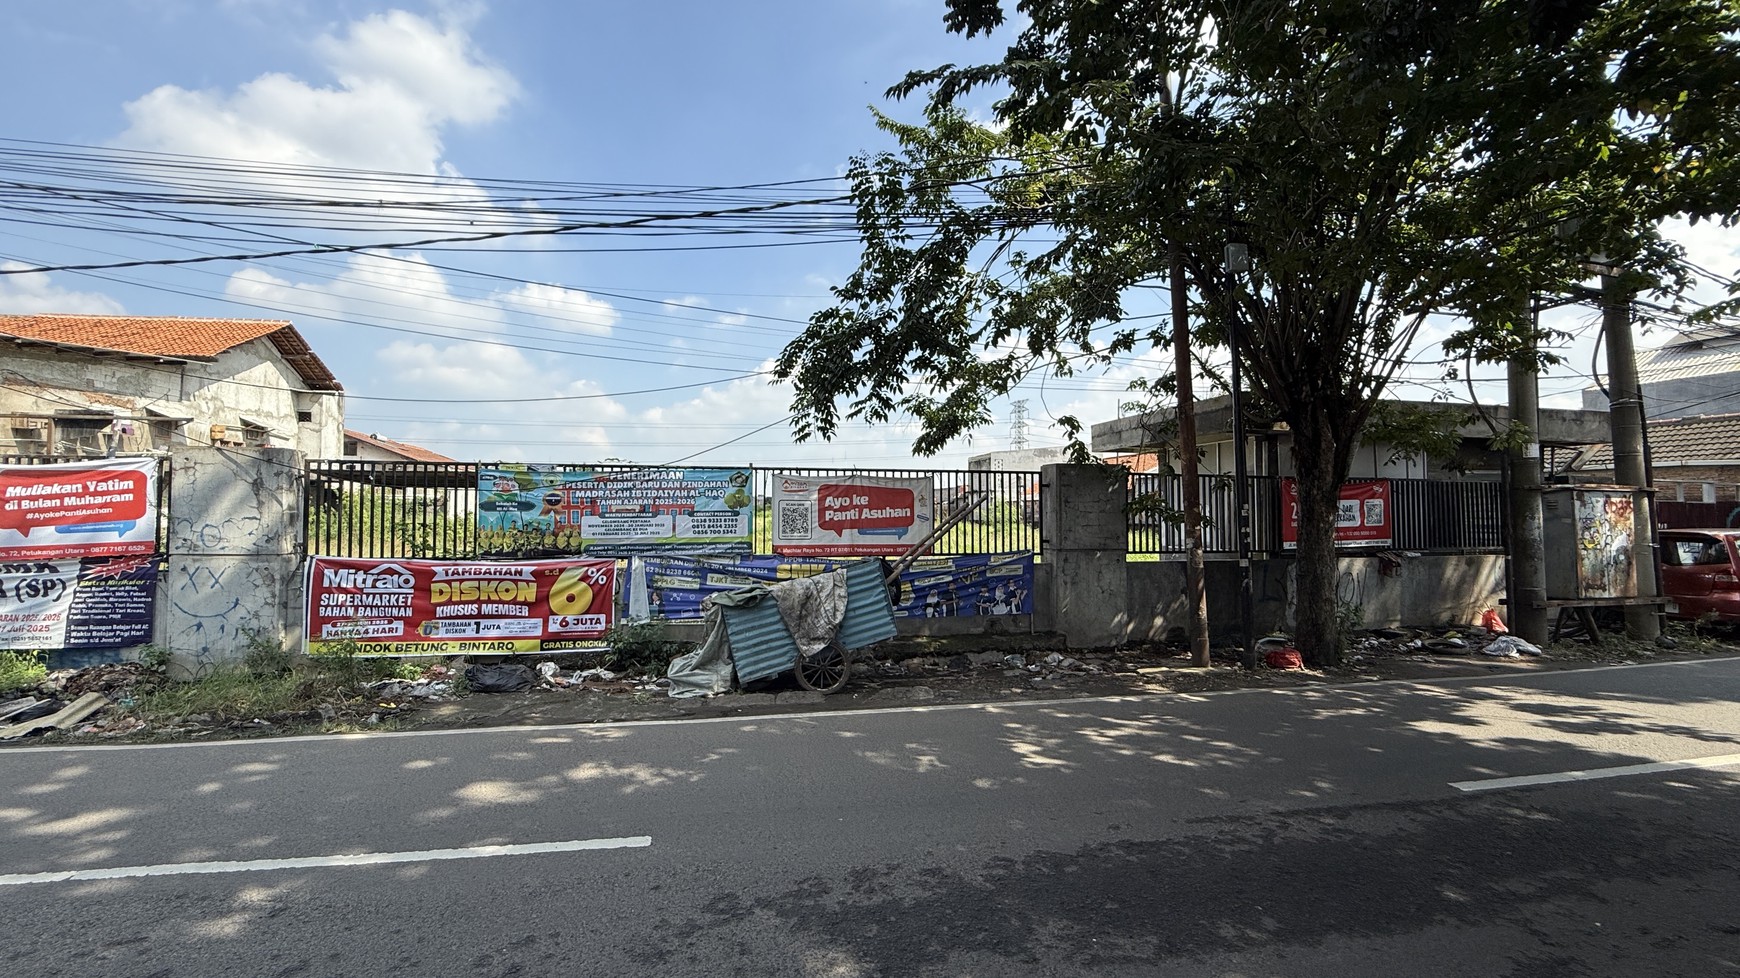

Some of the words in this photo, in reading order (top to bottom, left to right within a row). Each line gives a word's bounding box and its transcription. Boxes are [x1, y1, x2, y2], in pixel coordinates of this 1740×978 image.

[610, 472, 684, 480] PENERIMAAN
[5, 482, 83, 497] Muliakan
[86, 479, 134, 491] Yatim
[565, 481, 605, 489] PESERTA
[607, 481, 634, 489] DIDIK
[636, 481, 661, 489] BARU
[663, 481, 680, 489] DAN
[575, 491, 630, 499] MADRASAH
[632, 490, 688, 498] IBTIDAIYAH
[690, 490, 725, 498] AL-HAQ
[5, 501, 18, 511] di
[21, 498, 60, 510] Bulan
[64, 493, 134, 506] Muharram
[825, 496, 850, 509] Ayo
[852, 494, 868, 505] ke
[26, 507, 112, 519] #AyokePantiAsuhan
[825, 508, 859, 521] Panti
[861, 507, 910, 519] Asuhan
[21, 549, 64, 557] Petukangan
[65, 547, 85, 555] Utara
[91, 546, 108, 554] 0877
[443, 567, 523, 577] TAMBAHAN
[14, 578, 67, 602] (SP)
[430, 581, 537, 603] DISKON
[549, 566, 593, 615] 6
[587, 567, 607, 585] %
[320, 594, 414, 606] SUPERMARKET
[319, 606, 354, 618] BAHAN
[357, 606, 413, 618] BANGUNAN
[436, 604, 478, 617] KHUSUS
[481, 604, 529, 617] MEMBER
[473, 621, 481, 634] 1
[559, 616, 569, 628] 6
[572, 618, 602, 626] JUTA
[27, 624, 51, 633] 2025
[372, 627, 399, 635] HARI
[357, 643, 393, 653] NDOK
[395, 642, 449, 652] BETUNG
[458, 641, 515, 651] BINTARO
[543, 640, 573, 649] GRATIS
